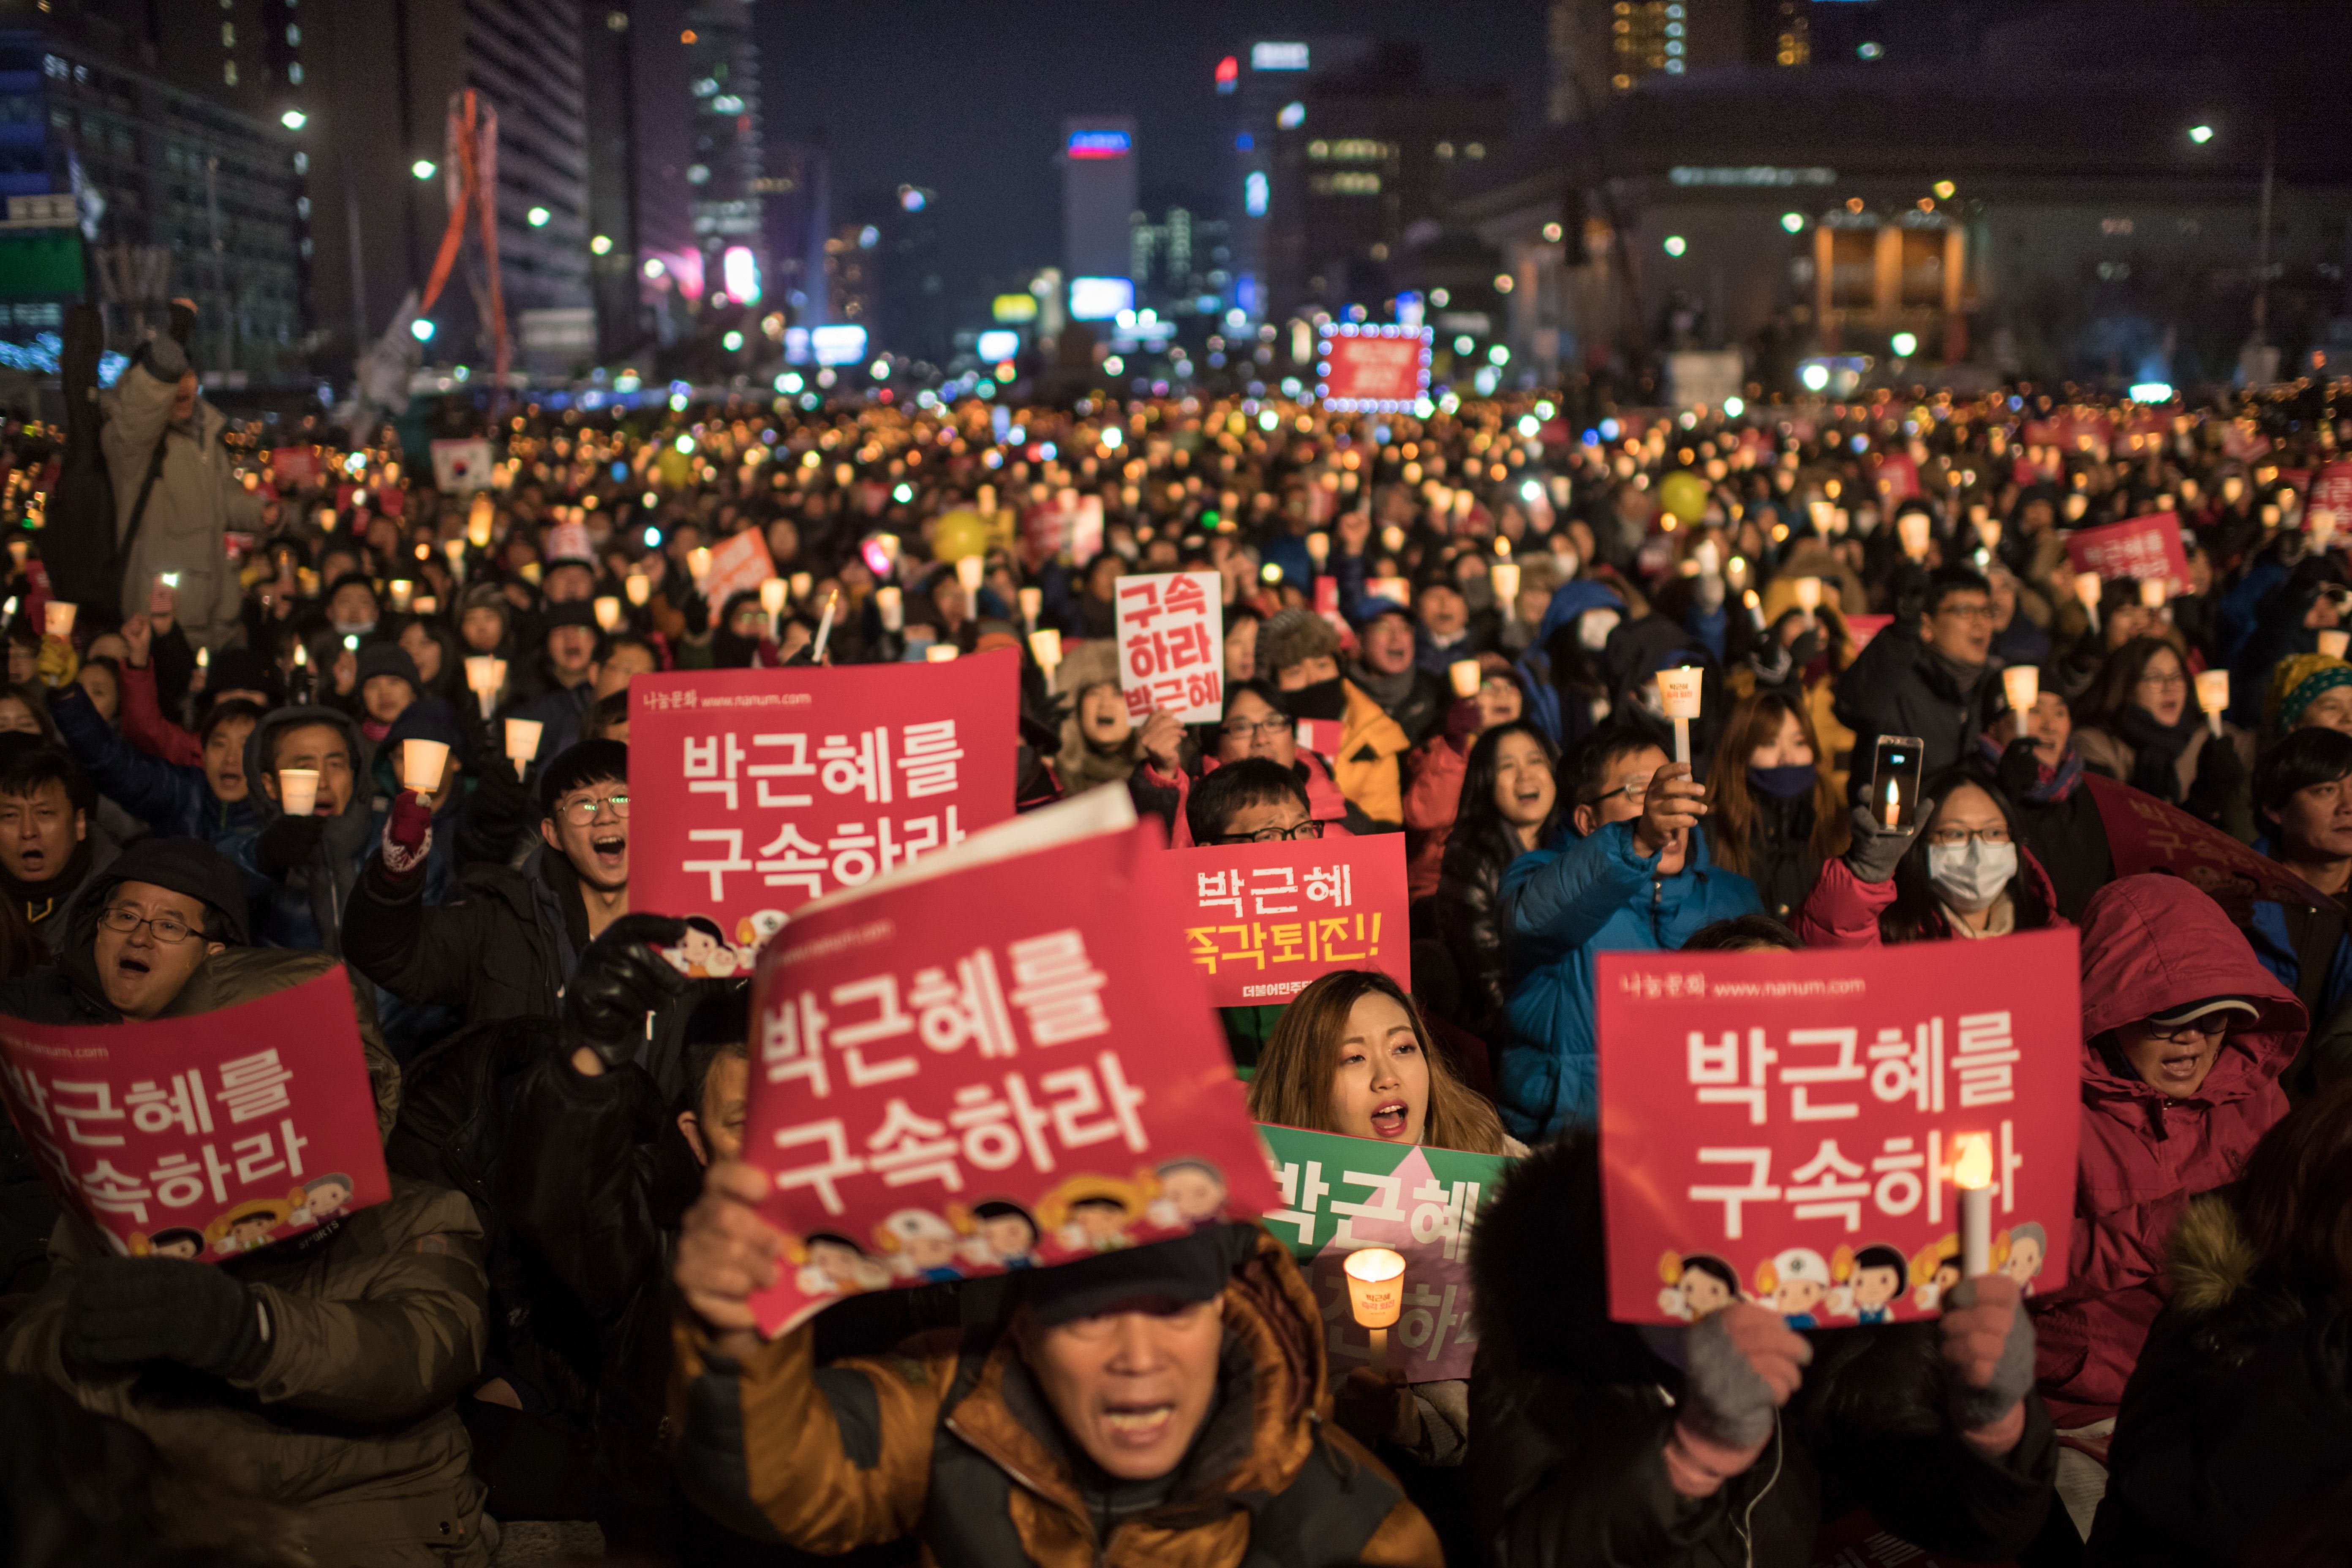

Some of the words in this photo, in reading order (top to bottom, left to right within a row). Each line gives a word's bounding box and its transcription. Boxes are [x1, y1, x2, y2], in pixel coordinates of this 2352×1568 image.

[1120, 574, 1207, 628] 구속
[1126, 622, 1213, 678] 하라
[643, 689, 697, 709] 나눔문화
[701, 693, 811, 708] www.nanum.com
[1124, 670, 1222, 717] 박근혜
[683, 719, 964, 810] 박근혜를
[683, 805, 966, 901] 구속하라
[1198, 864, 1352, 917] 박근혜
[1185, 912, 1382, 975] 즉각퇴진!
[762, 928, 1111, 1097] 박근혜를
[1713, 979, 1865, 997] www.nanum.com
[0, 1048, 293, 1146] 박근혜를
[1687, 1010, 2020, 1125] 박근혜를
[773, 1048, 1149, 1216] 구속하라
[1263, 1160, 1481, 1263] 박근혜
[1366, 1293, 1391, 1302] 박근혜
